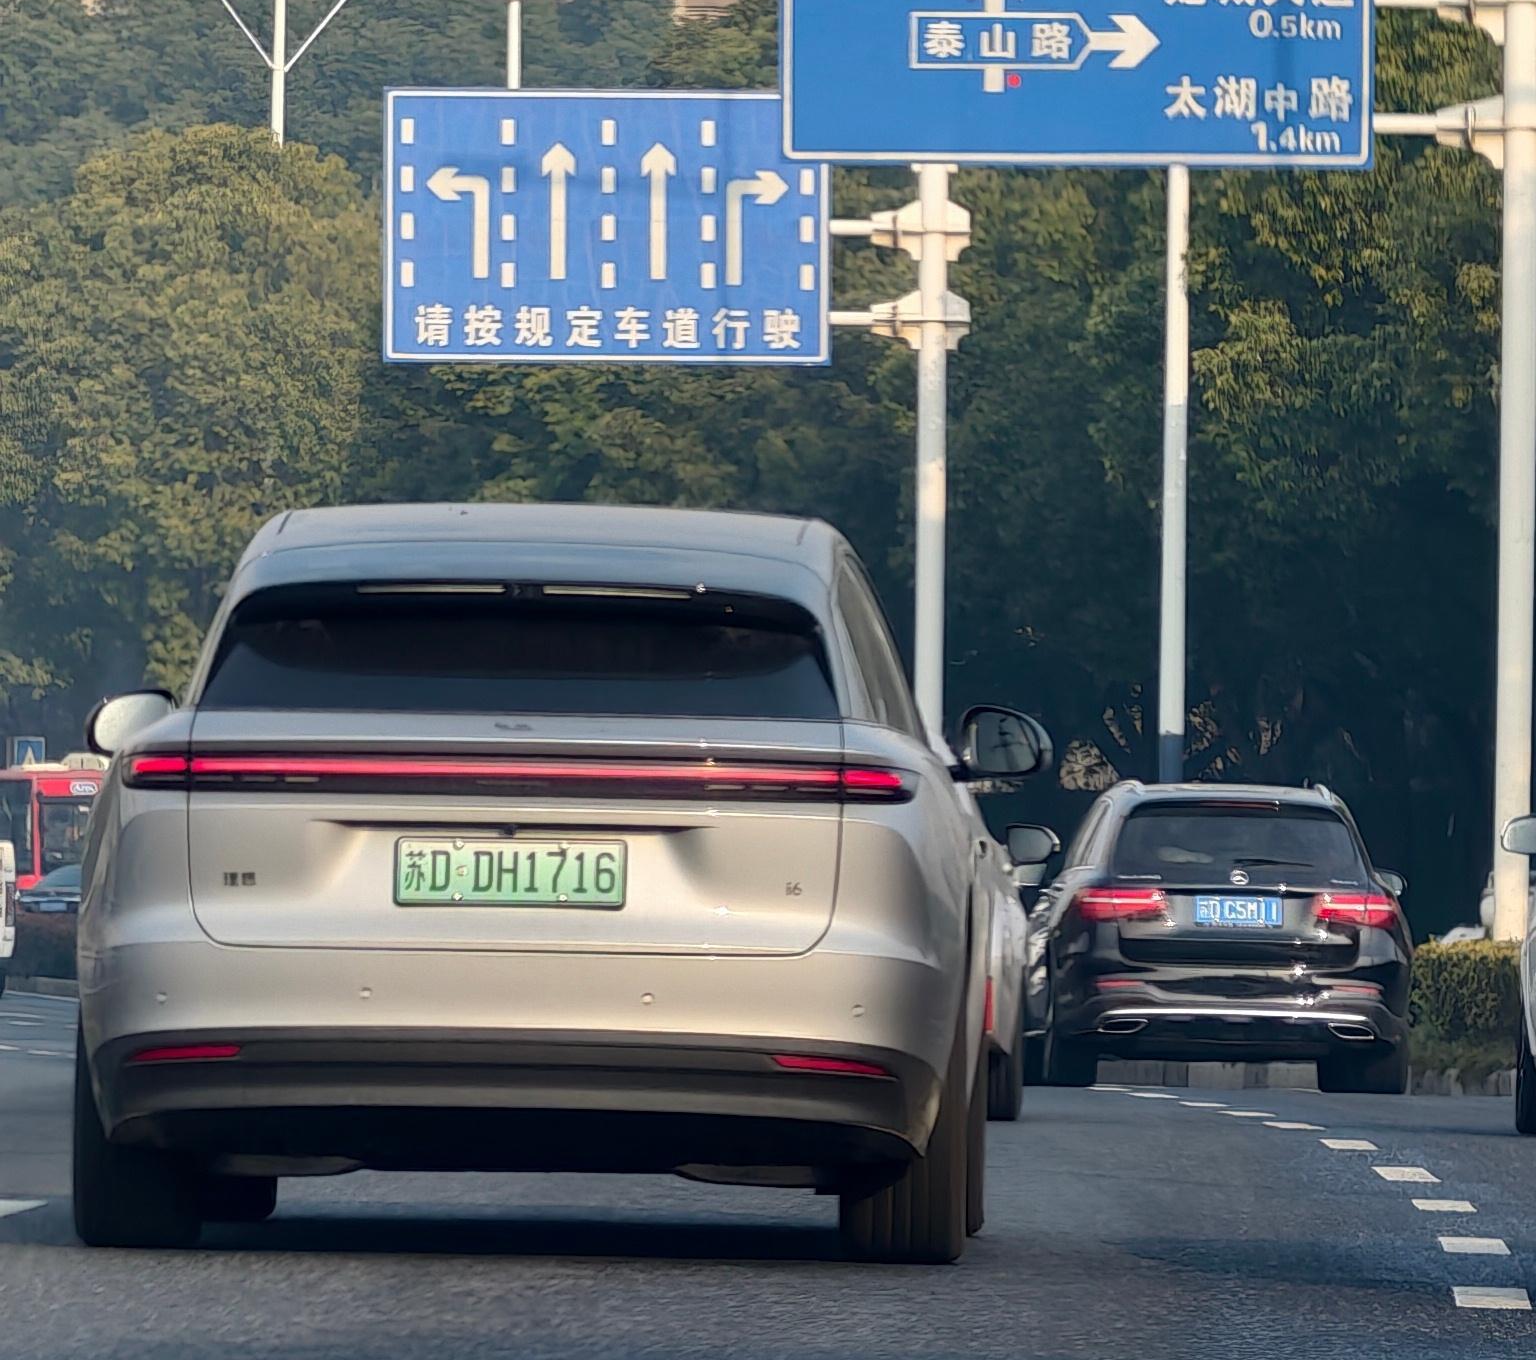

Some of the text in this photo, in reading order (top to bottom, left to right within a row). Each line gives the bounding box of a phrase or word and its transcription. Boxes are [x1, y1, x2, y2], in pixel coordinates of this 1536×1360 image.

[923, 20, 1072, 60] 泰山路
[1248, 8, 1342, 40] 0.5km
[1163, 74, 1354, 123] 太湖中路
[1250, 120, 1342, 153] 1.4km
[414, 302, 802, 350] 请按规定车道行驶
